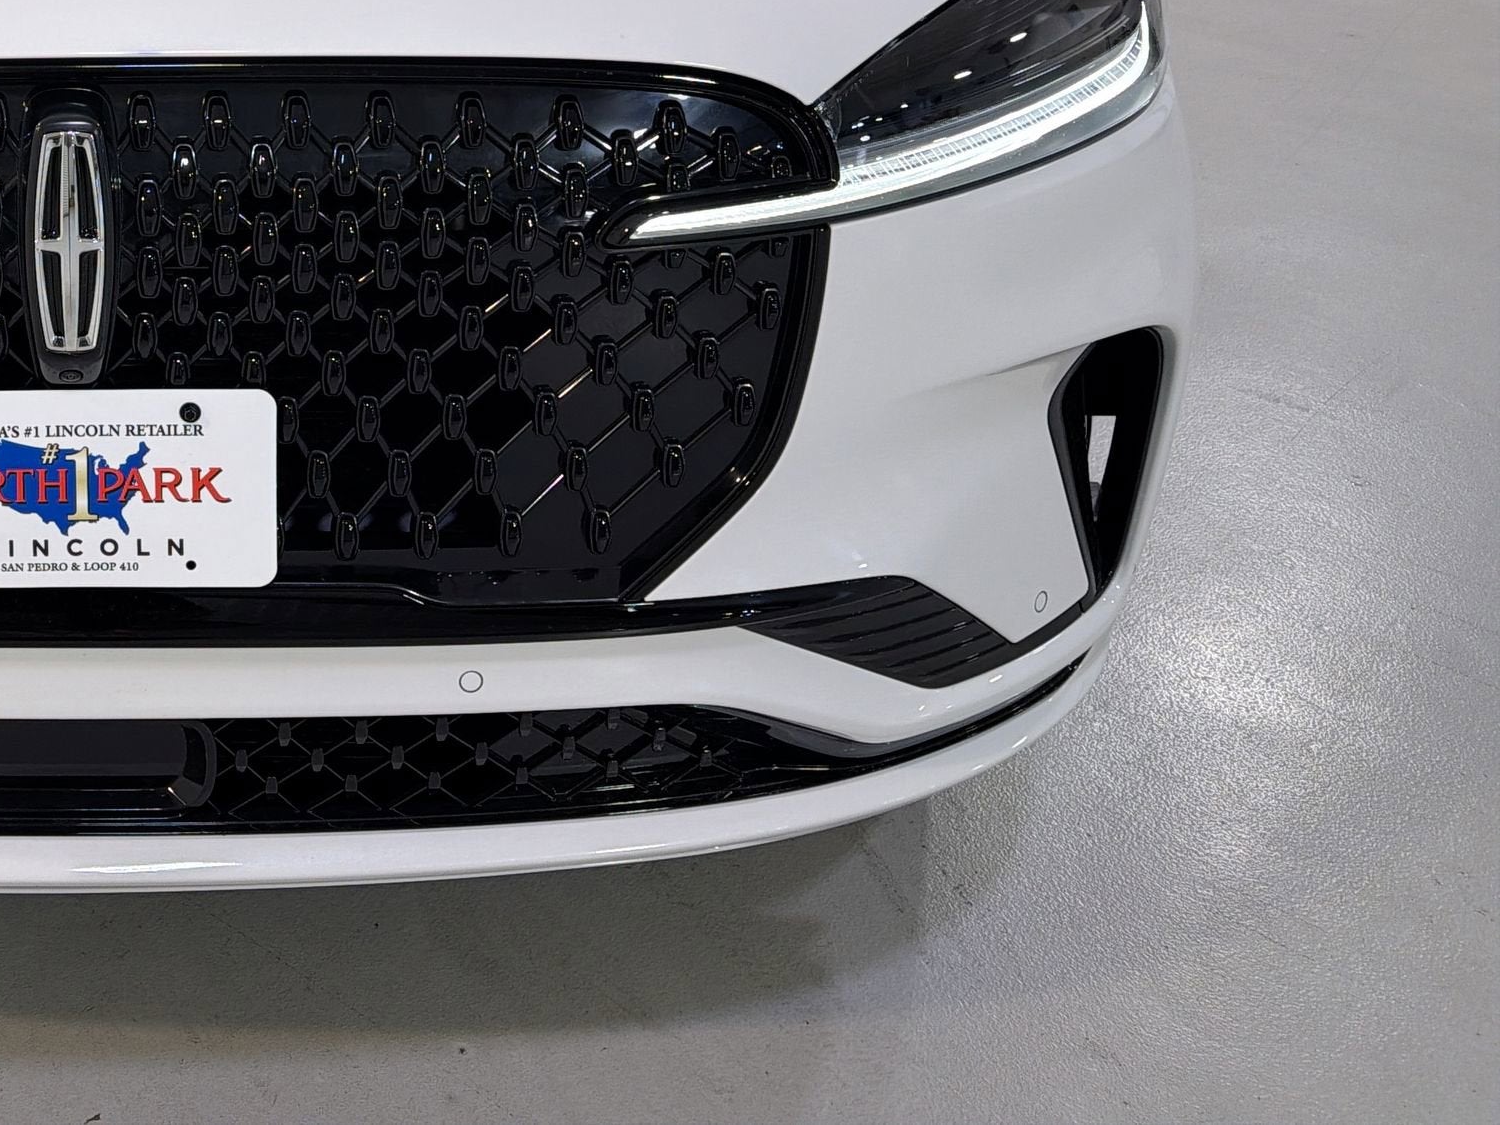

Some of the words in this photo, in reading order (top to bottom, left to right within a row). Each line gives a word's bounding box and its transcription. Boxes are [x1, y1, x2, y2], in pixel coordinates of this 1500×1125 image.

[23, 426, 40, 438] #1
[45, 424, 120, 437] LINCOLN
[125, 423, 204, 437] RETAILER
[96, 467, 232, 504] PARK
[1, 562, 24, 572] SAN
[27, 562, 68, 572] PEDRO
[71, 562, 81, 572] &
[84, 562, 116, 572] LOOP
[119, 562, 139, 572] 410
